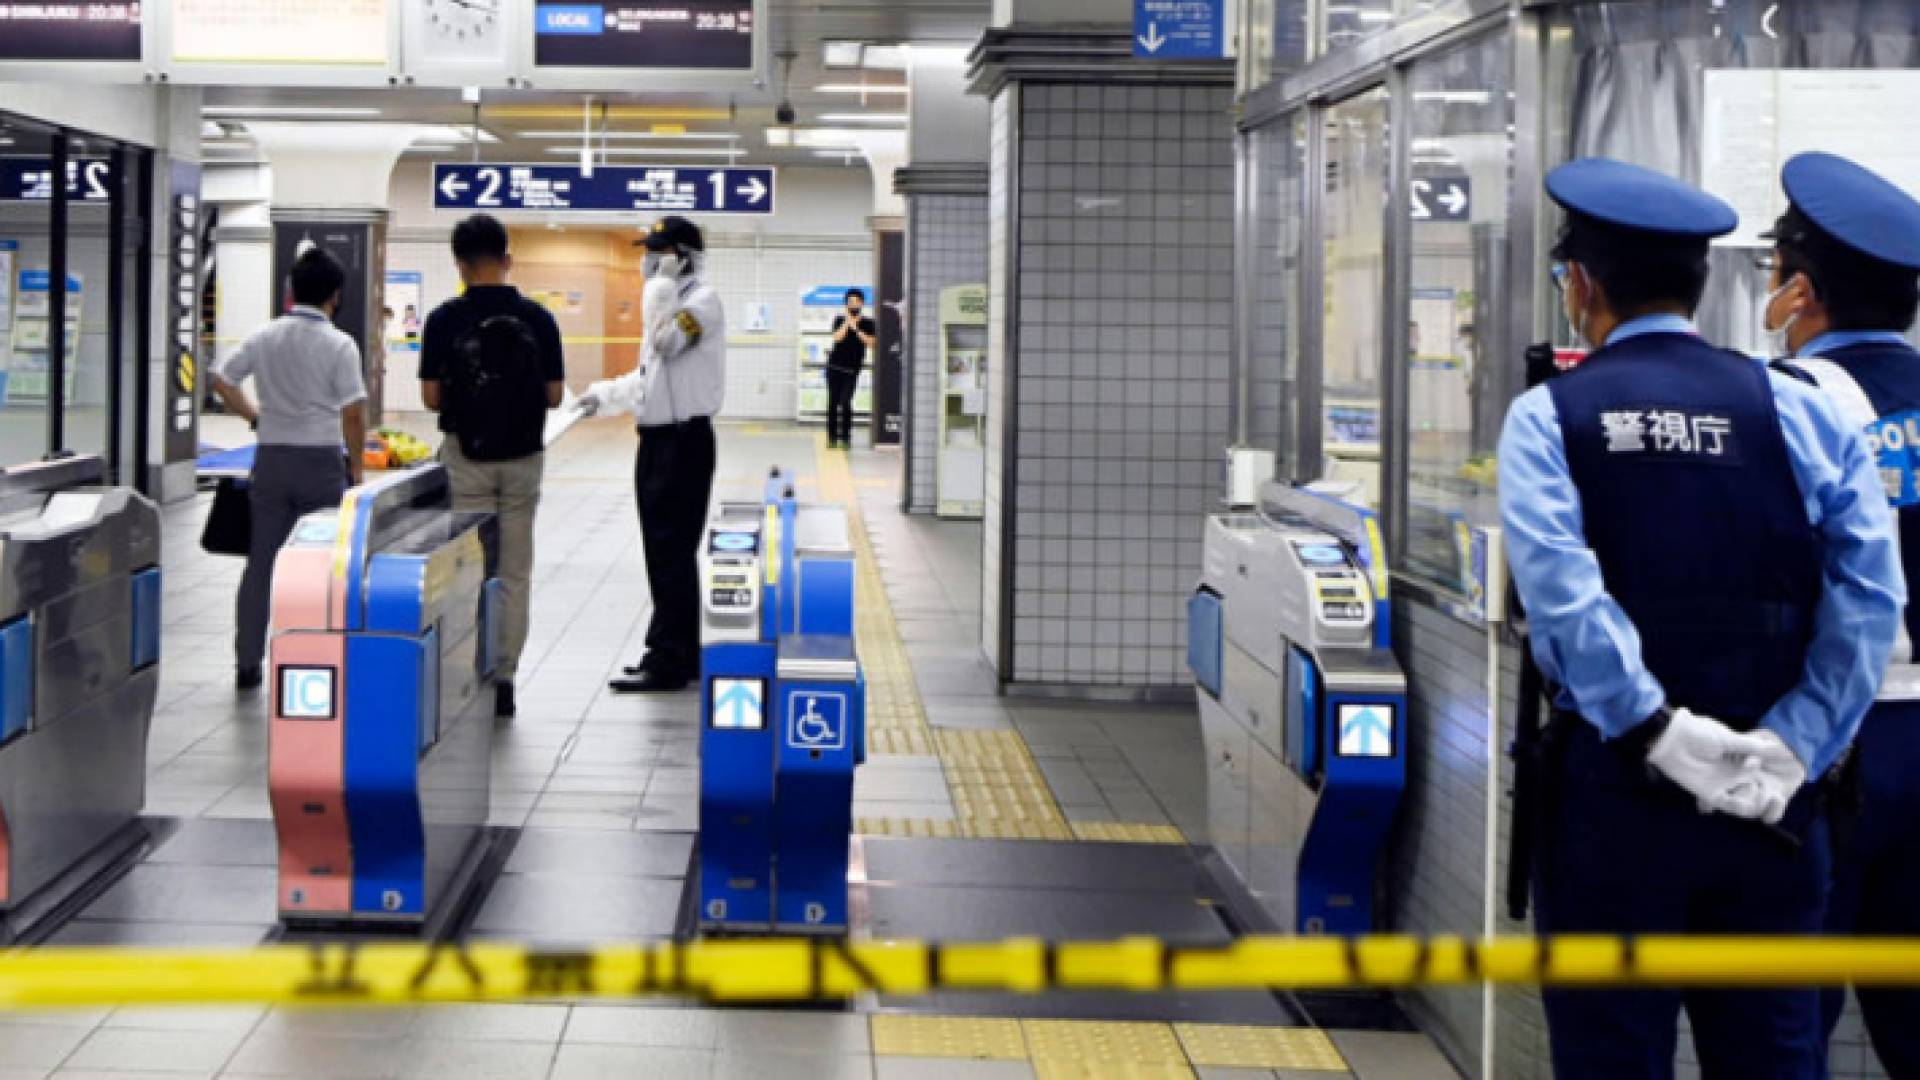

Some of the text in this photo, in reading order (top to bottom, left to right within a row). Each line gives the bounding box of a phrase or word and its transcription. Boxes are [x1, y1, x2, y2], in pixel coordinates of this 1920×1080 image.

[547, 13, 590, 27] LOCAL
[474, 168, 501, 206] 2
[707, 171, 726, 209] 1
[1600, 410, 1732, 455] 警視庁
[288, 673, 329, 713] IC
